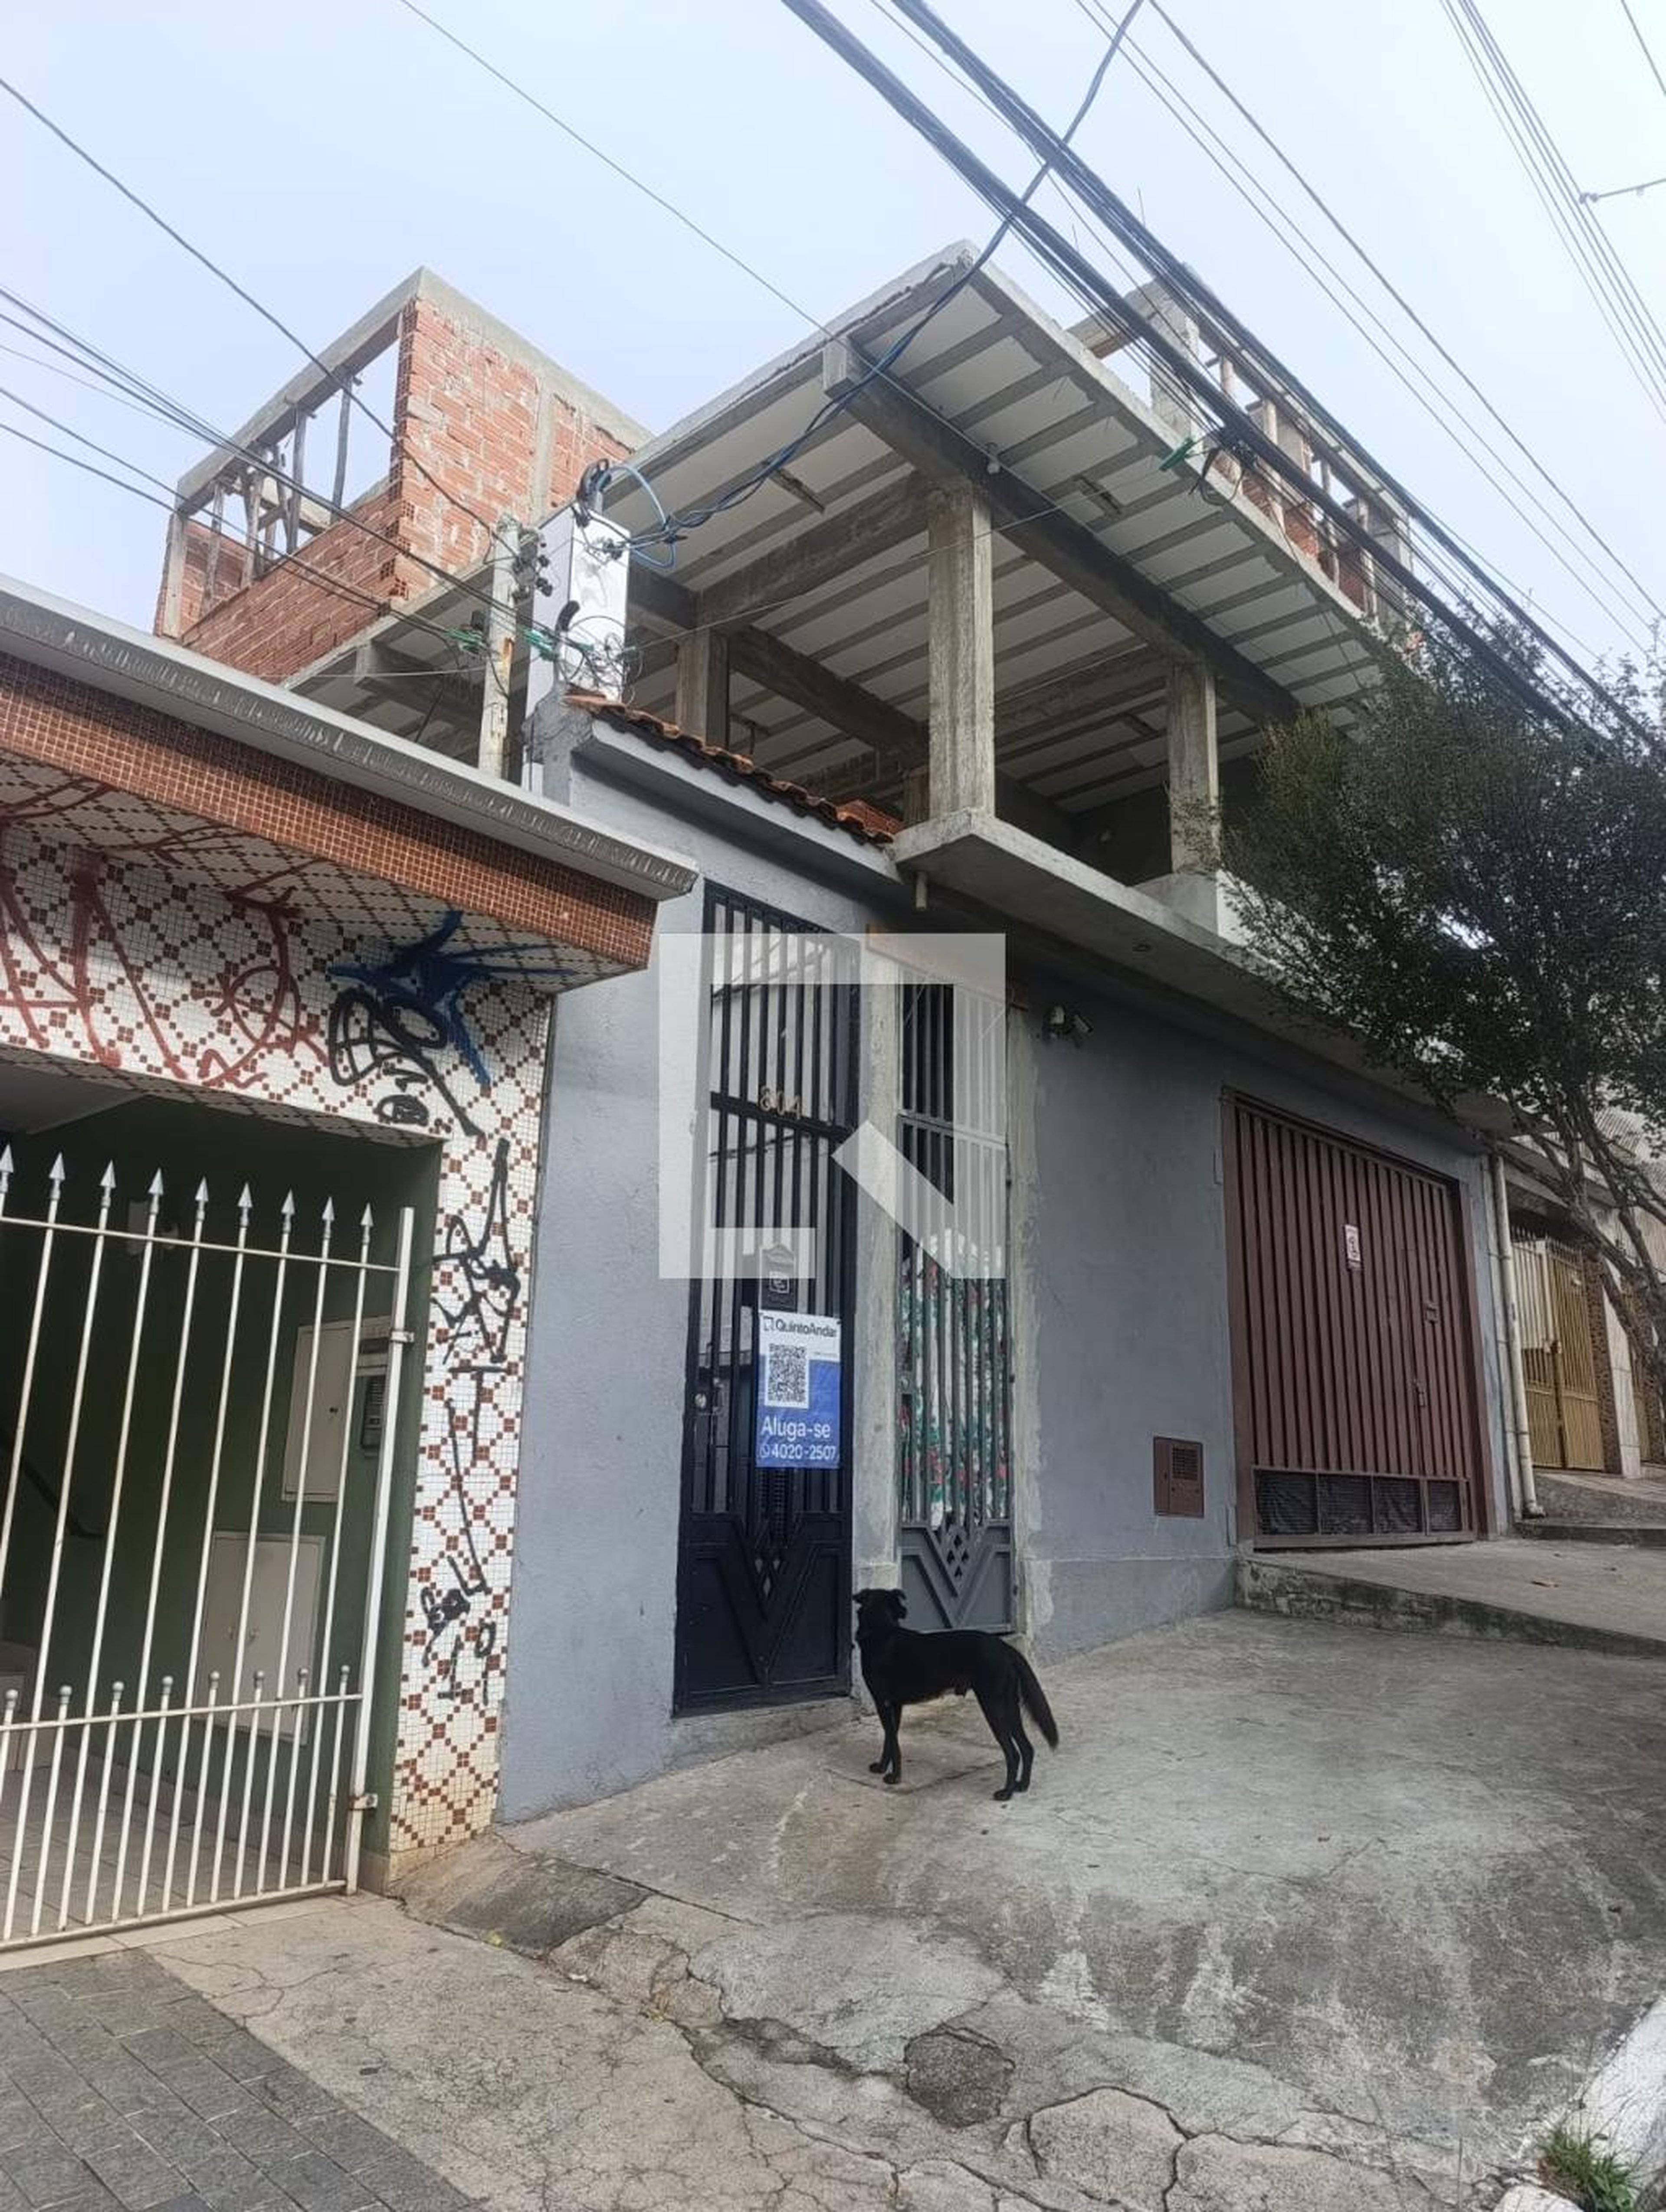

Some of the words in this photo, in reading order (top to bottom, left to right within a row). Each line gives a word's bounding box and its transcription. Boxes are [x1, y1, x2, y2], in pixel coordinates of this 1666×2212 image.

[776, 1319, 837, 1338] QuintoAndar
[761, 1415, 831, 1442] Aluga-se
[772, 1443, 836, 1461] 4020-2507
